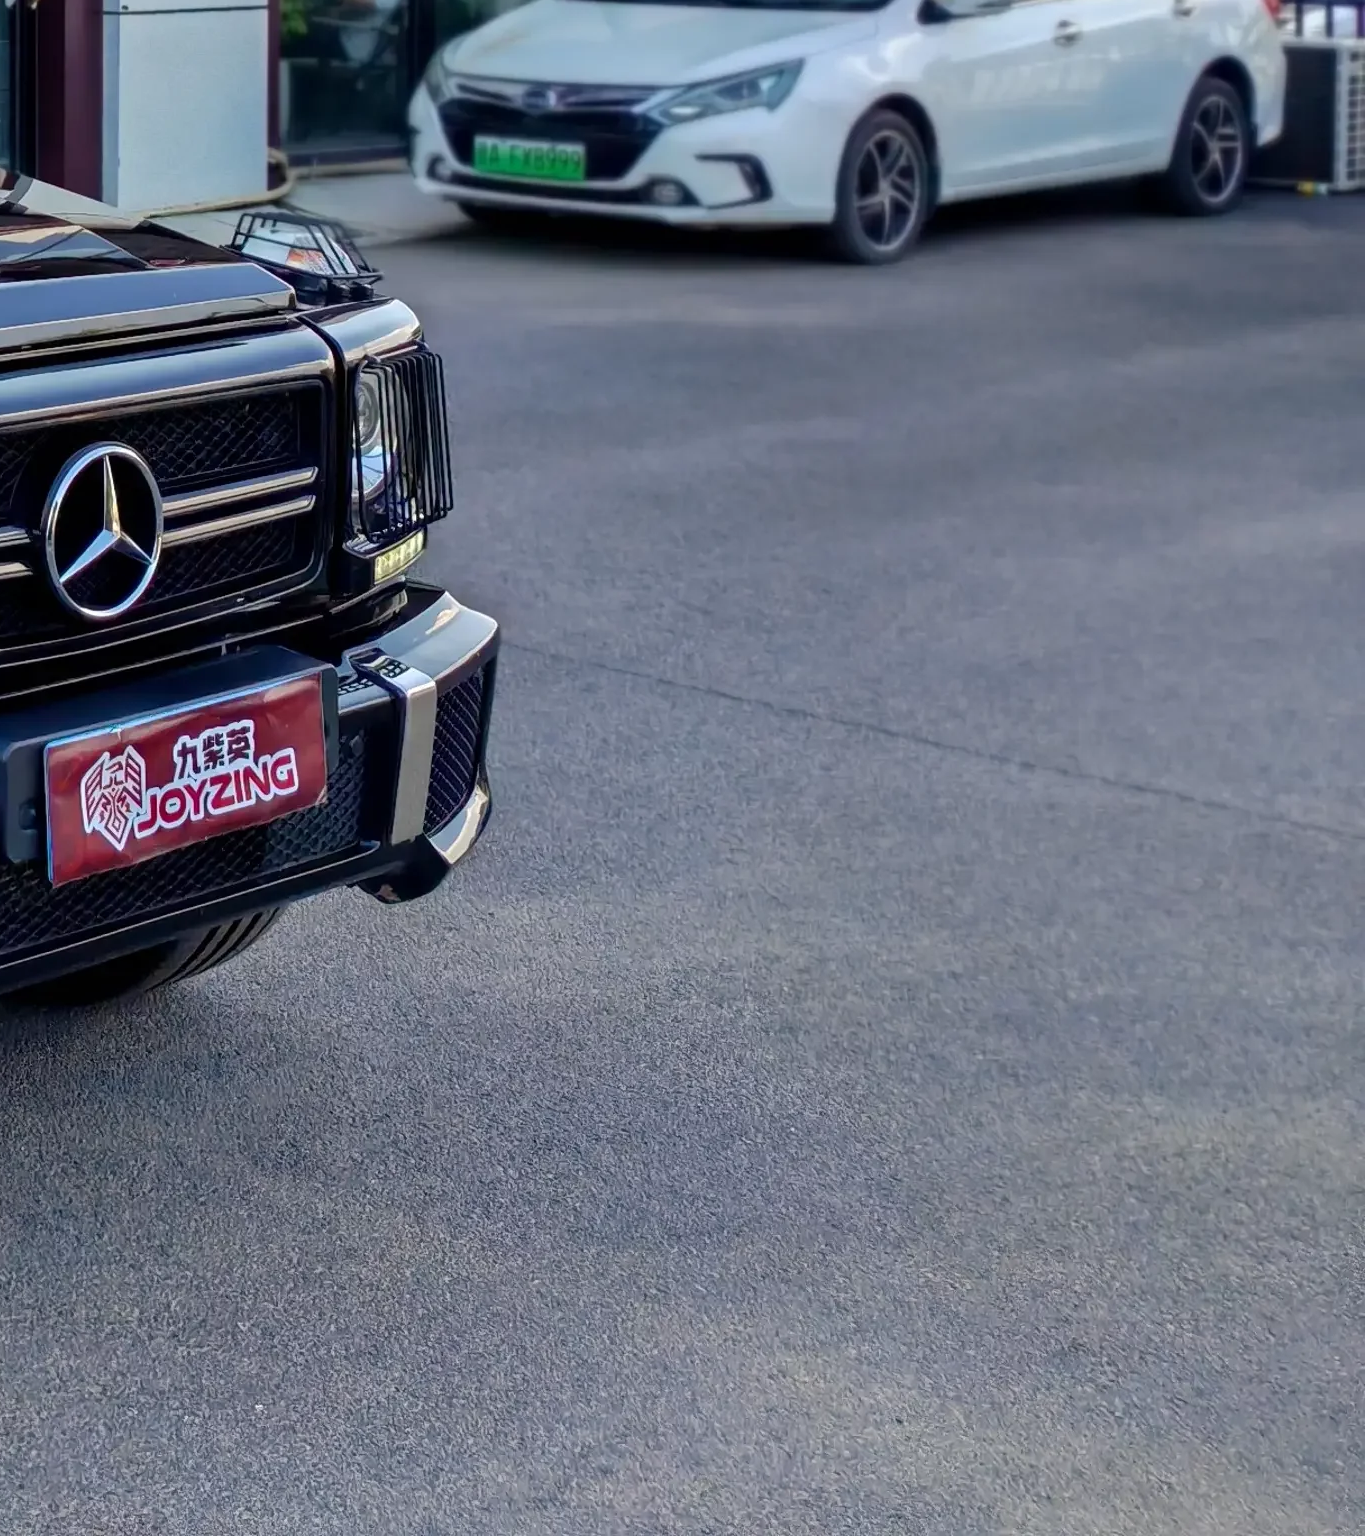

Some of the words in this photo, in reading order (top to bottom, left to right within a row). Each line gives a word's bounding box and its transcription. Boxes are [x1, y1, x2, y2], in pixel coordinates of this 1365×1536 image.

[175, 723, 253, 779] 九紫英
[137, 751, 296, 836] JOYZING
